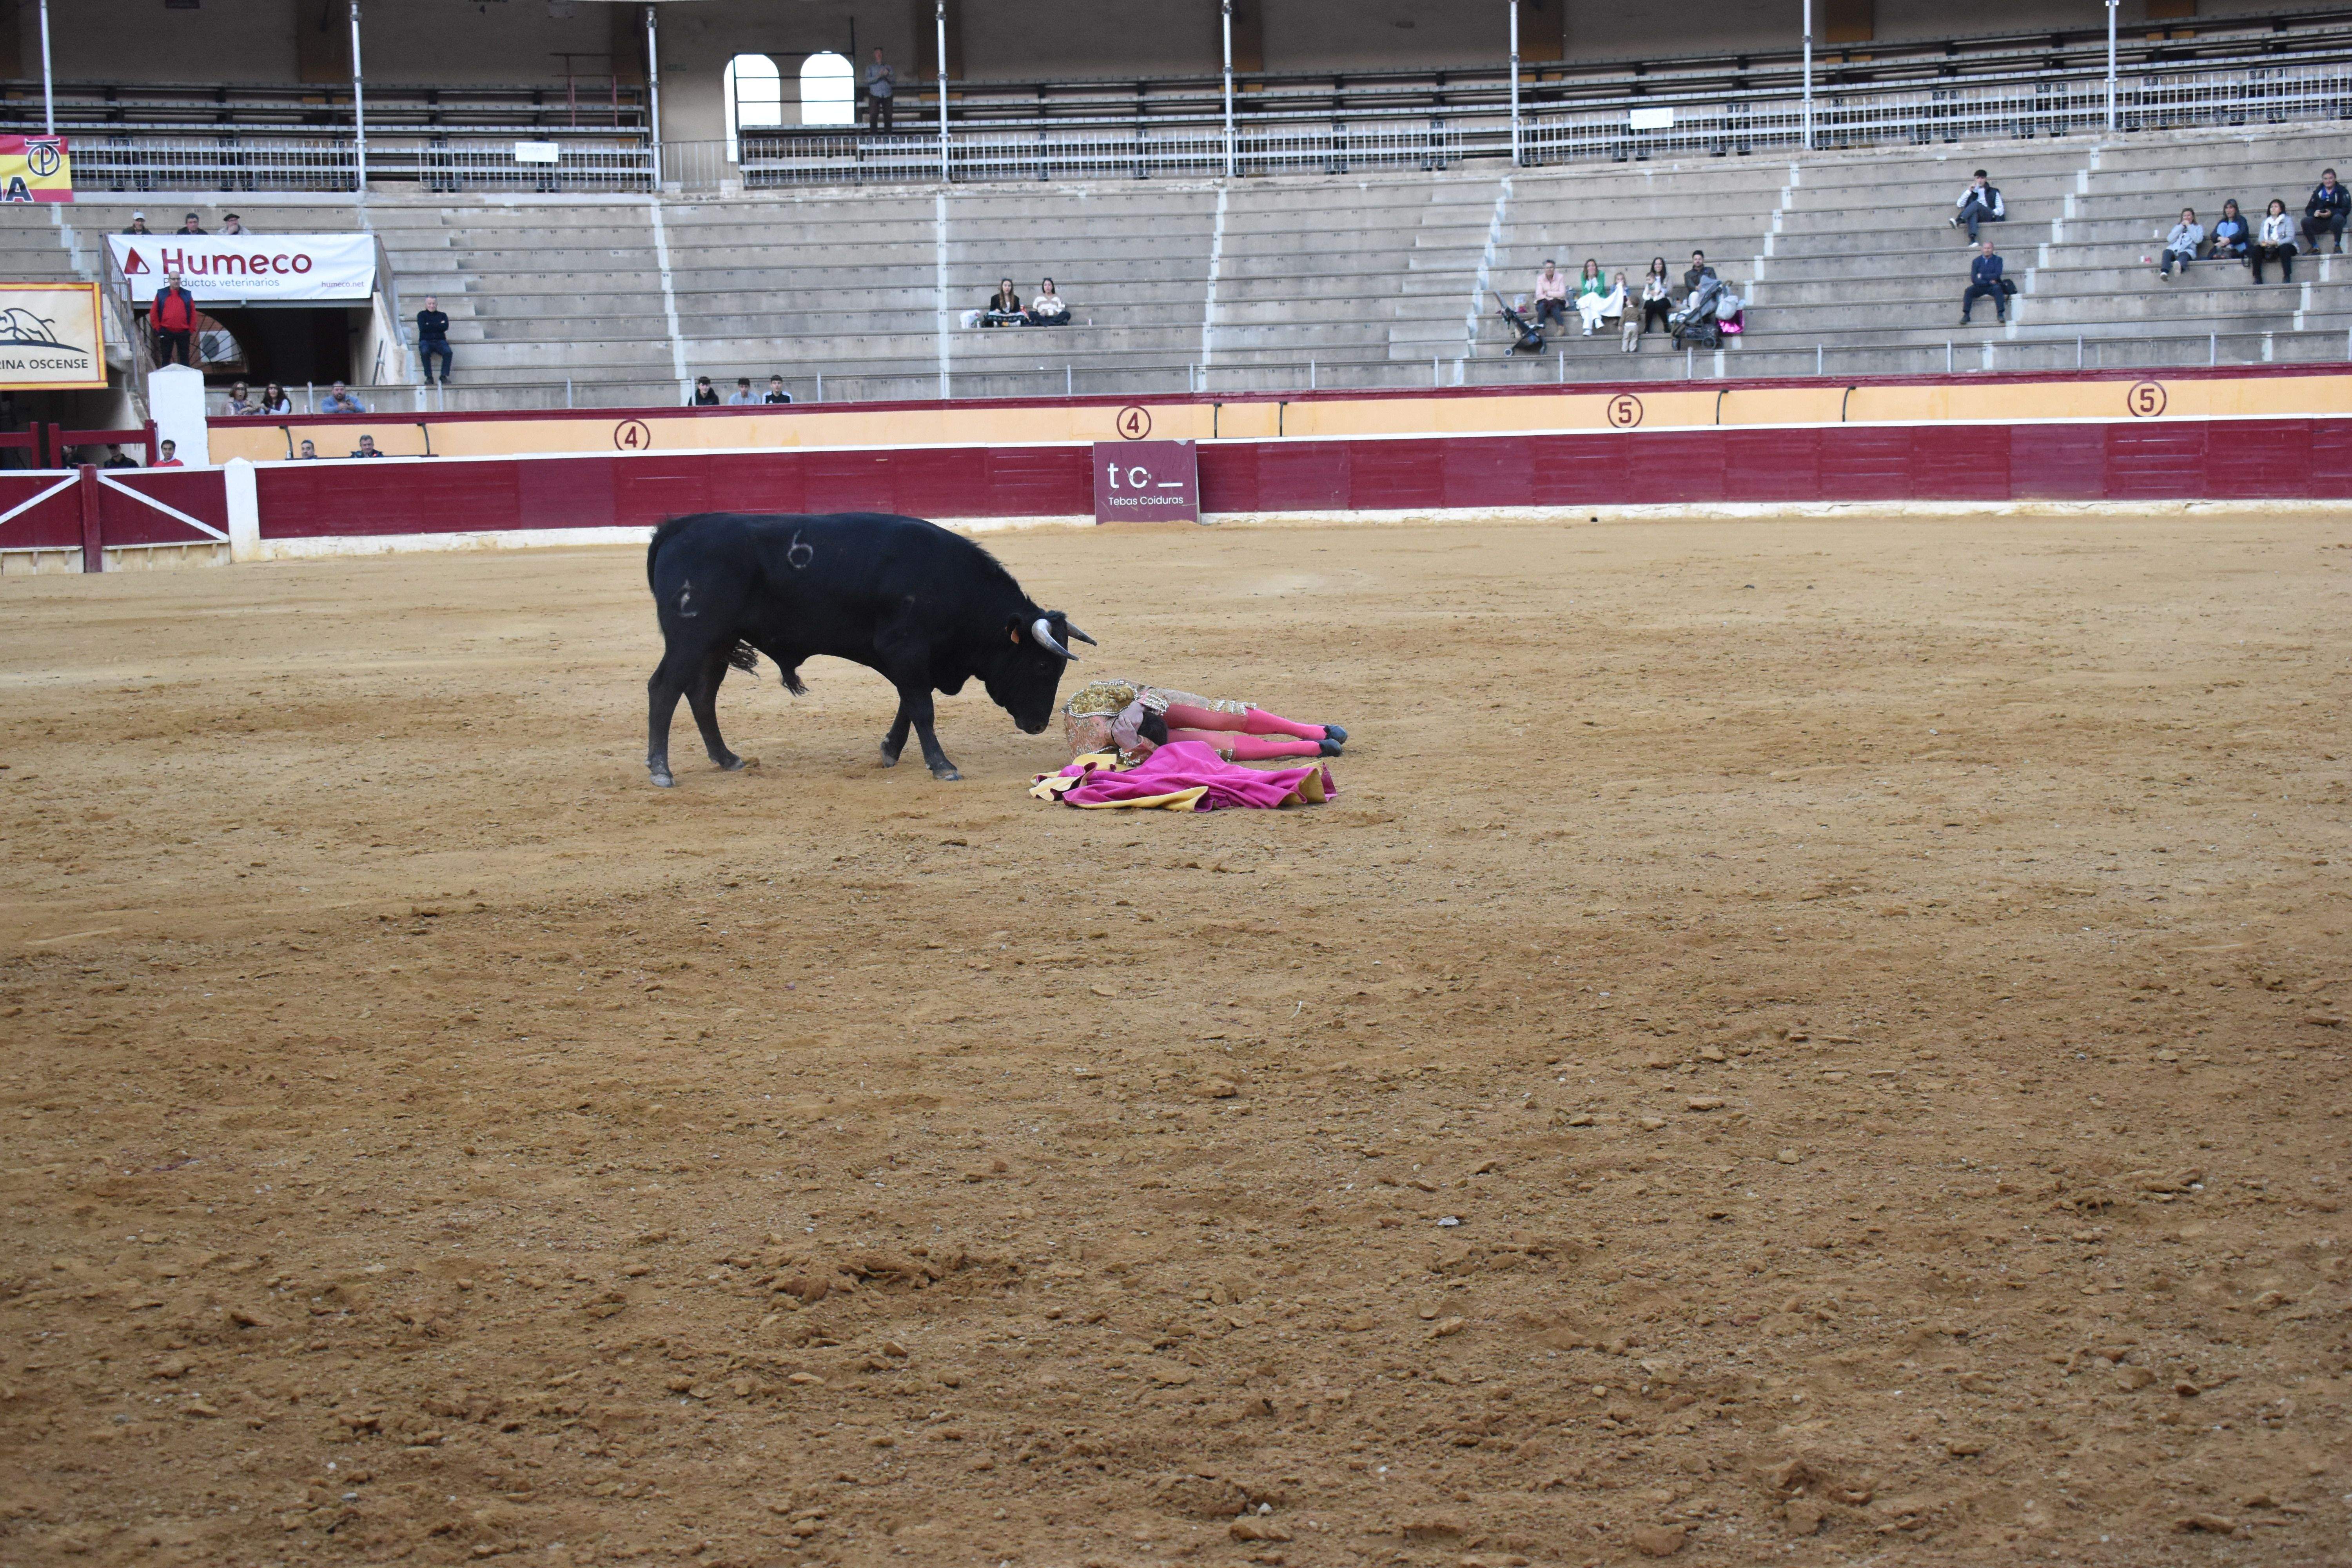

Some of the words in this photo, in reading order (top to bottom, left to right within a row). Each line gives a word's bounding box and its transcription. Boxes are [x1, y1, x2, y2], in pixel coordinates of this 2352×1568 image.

[0, 176, 34, 202] A
[162, 248, 312, 275] Humeco
[163, 278, 216, 287] Pductos
[219, 278, 279, 287] veterinarios
[0, 359, 25, 369] INA
[29, 359, 89, 369] OSCENSE
[2140, 388, 2155, 412] 5
[1126, 412, 1140, 433] 4
[1618, 401, 1632, 424] 5
[624, 426, 638, 448] 4
[1109, 497, 1137, 506] Tebas
[1140, 496, 1183, 505] Coiduras
[787, 529, 813, 570] 6
